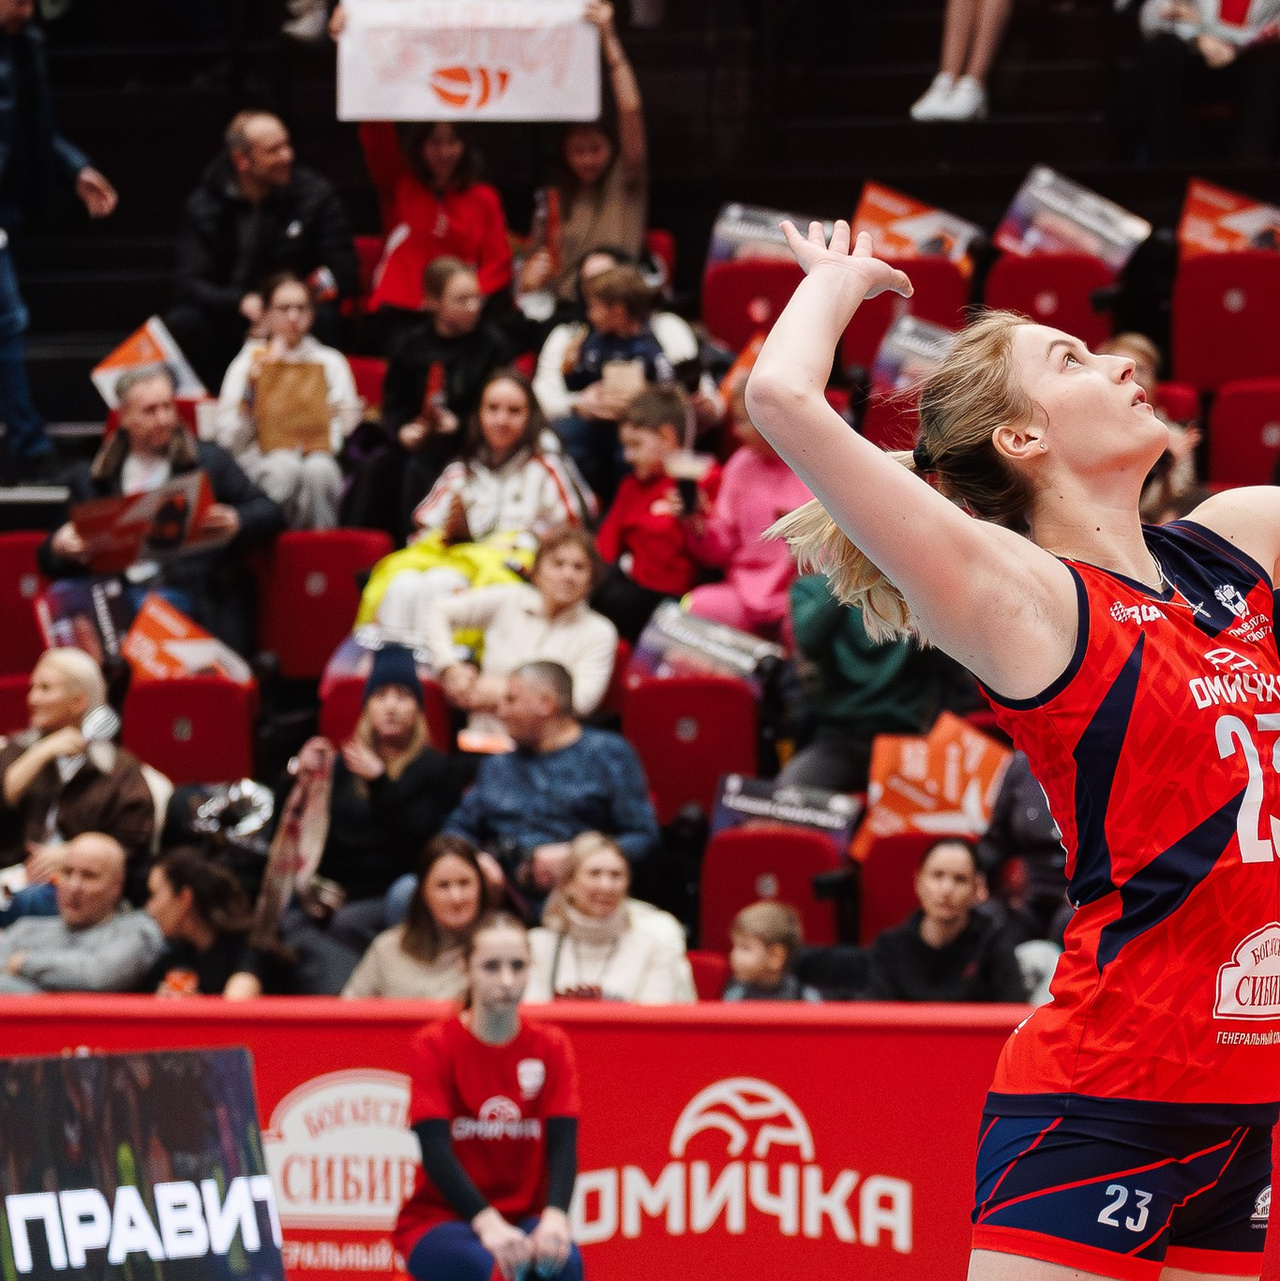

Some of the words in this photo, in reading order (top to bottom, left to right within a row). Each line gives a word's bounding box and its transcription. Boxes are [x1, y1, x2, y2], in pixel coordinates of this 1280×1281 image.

[281, 1154, 416, 1204] СИБИР
[570, 1160, 913, 1255] ОМИЧКА
[1097, 1184, 1153, 1233] 23
